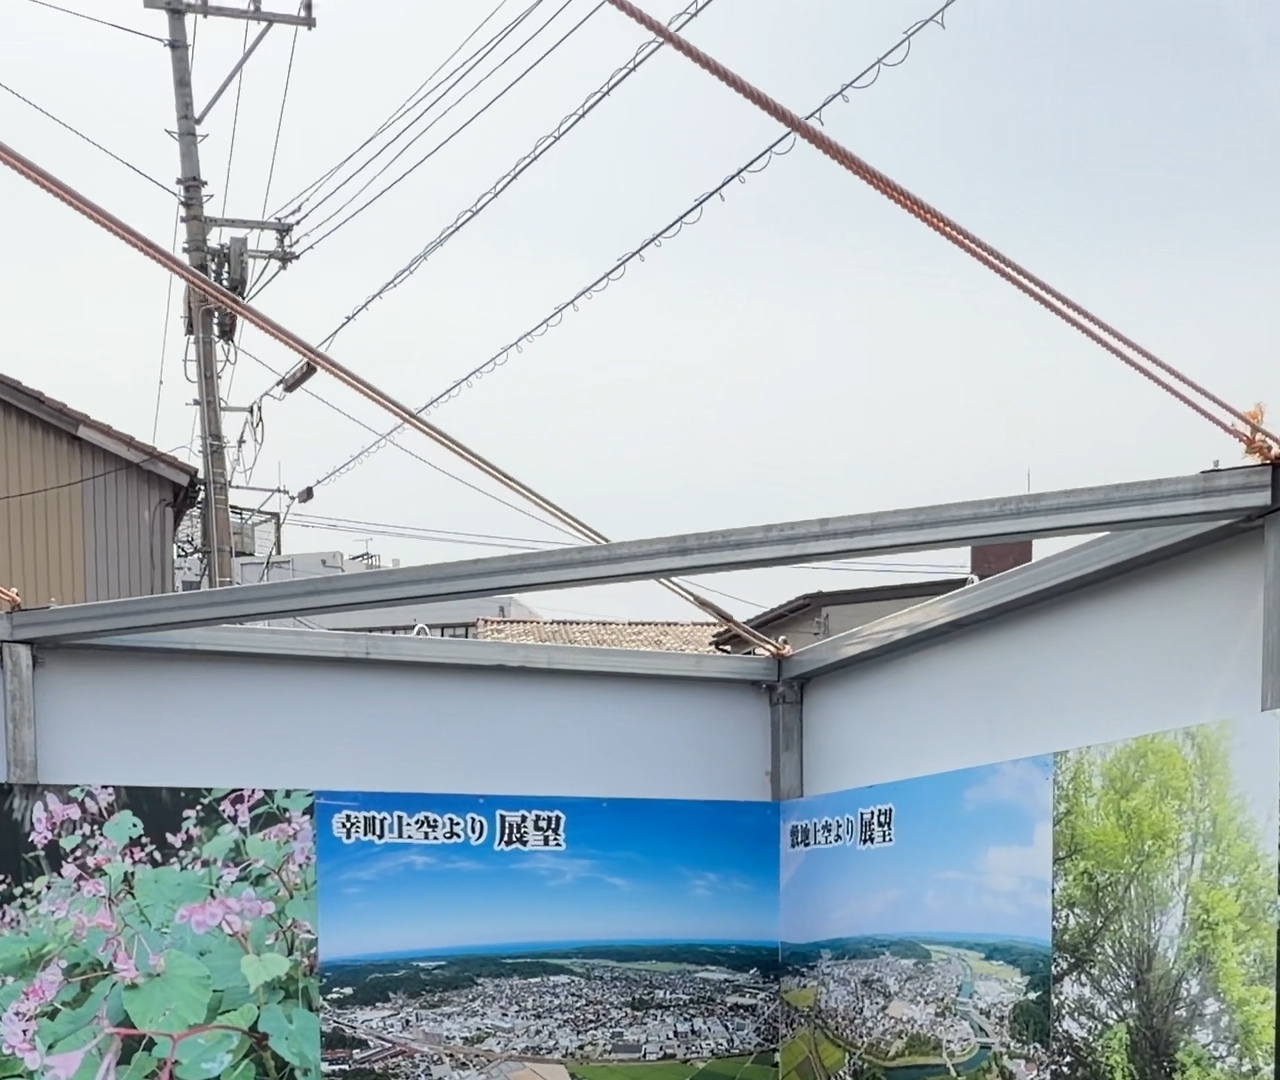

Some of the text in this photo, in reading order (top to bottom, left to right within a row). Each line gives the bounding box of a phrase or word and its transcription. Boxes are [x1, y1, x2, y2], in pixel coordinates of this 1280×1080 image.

[336, 812, 563, 848] 幸町上空より 展望
[859, 807, 893, 846] 展望
